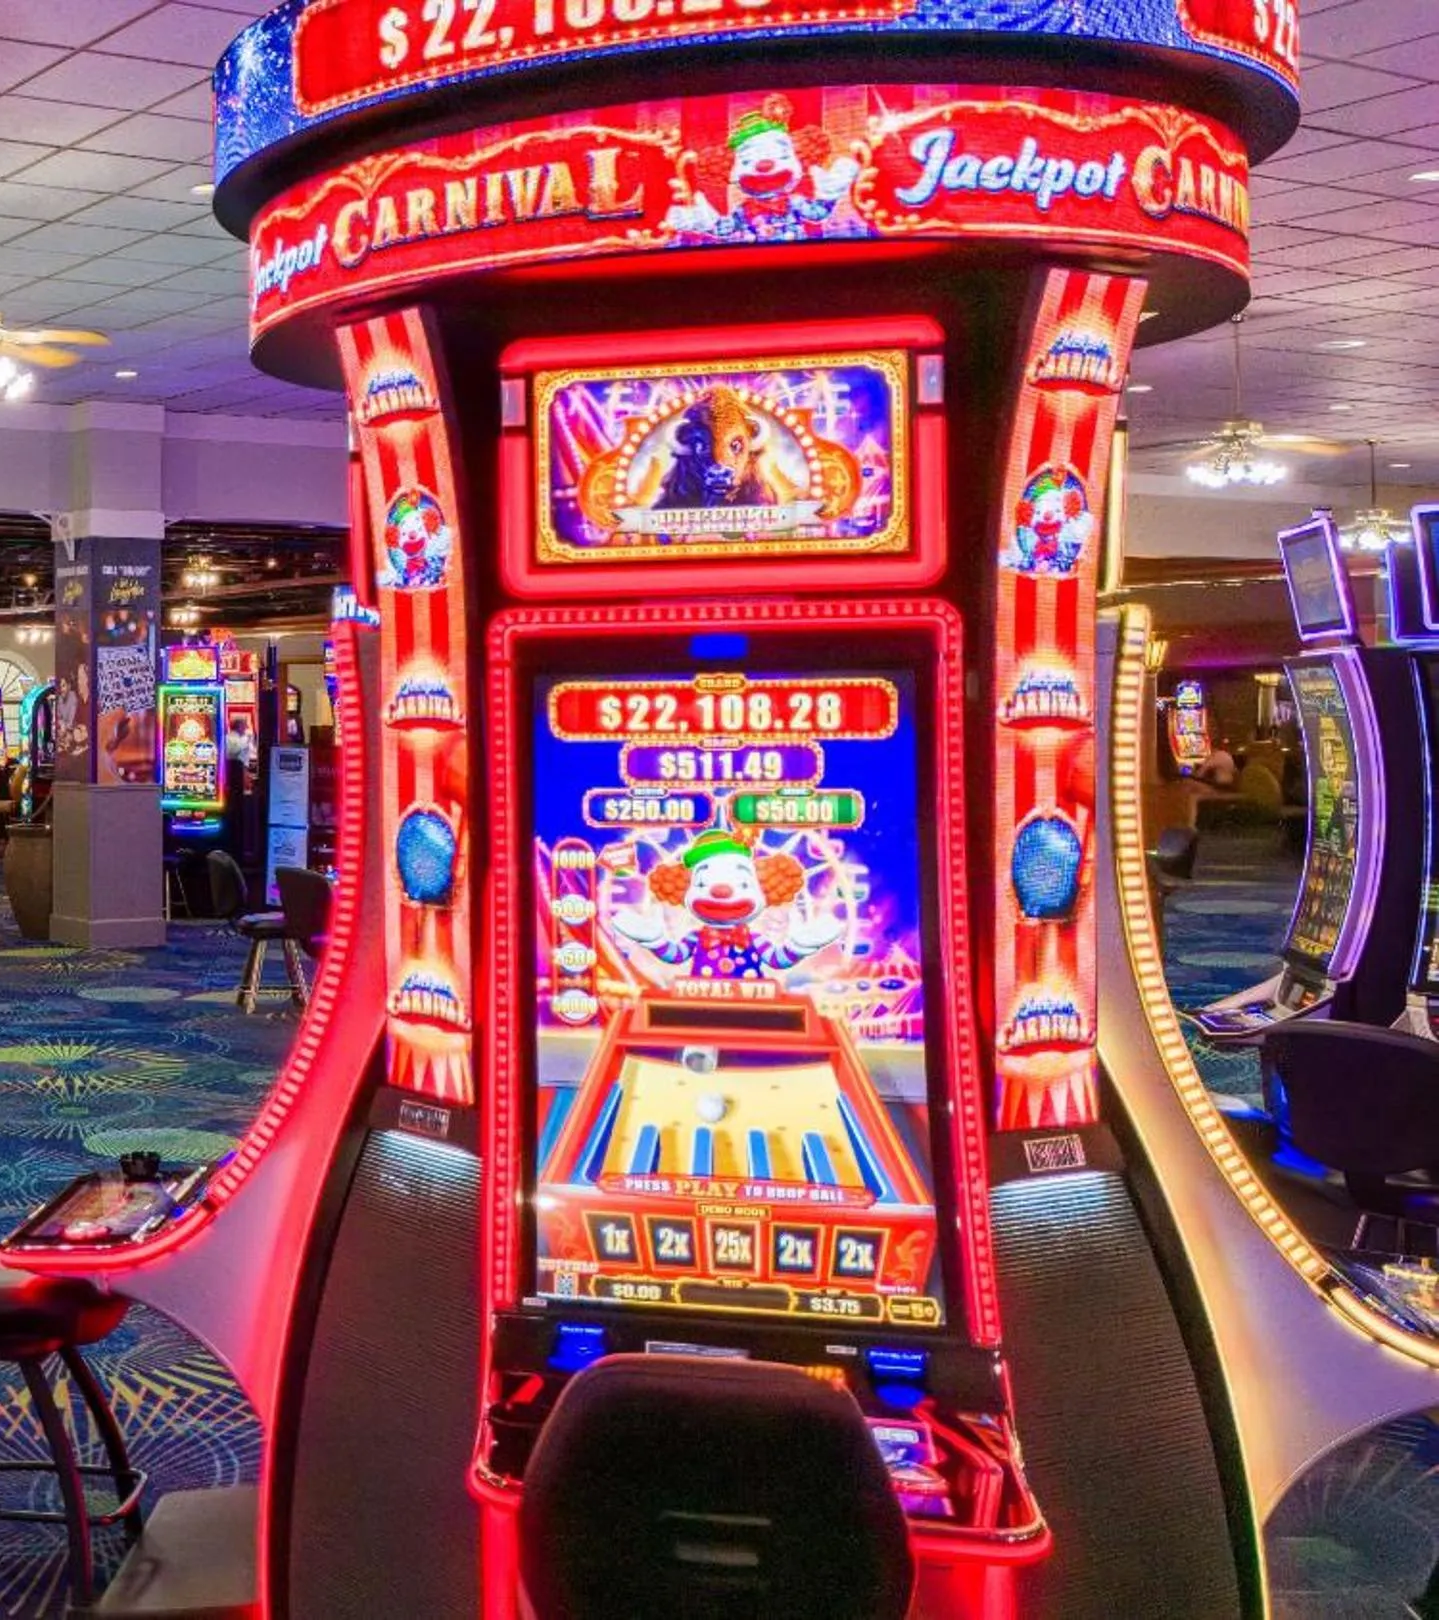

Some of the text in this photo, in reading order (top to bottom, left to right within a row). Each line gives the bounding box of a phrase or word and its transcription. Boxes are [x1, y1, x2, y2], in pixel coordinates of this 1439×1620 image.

[895, 127, 1128, 213] Jackpot
[332, 147, 646, 269] CARNIVAL
[599, 692, 842, 733] $22,108.28
[659, 751, 783, 780] $511.49
[604, 799, 696, 821] $250.00
[756, 799, 835, 823] $50.00
[675, 979, 776, 999] TOTAL WIN
[624, 1178, 670, 1192] PRESS
[675, 1180, 741, 1198] PLAY
[612, 1283, 662, 1300] $0.00
[810, 1297, 861, 1315] $3.75
